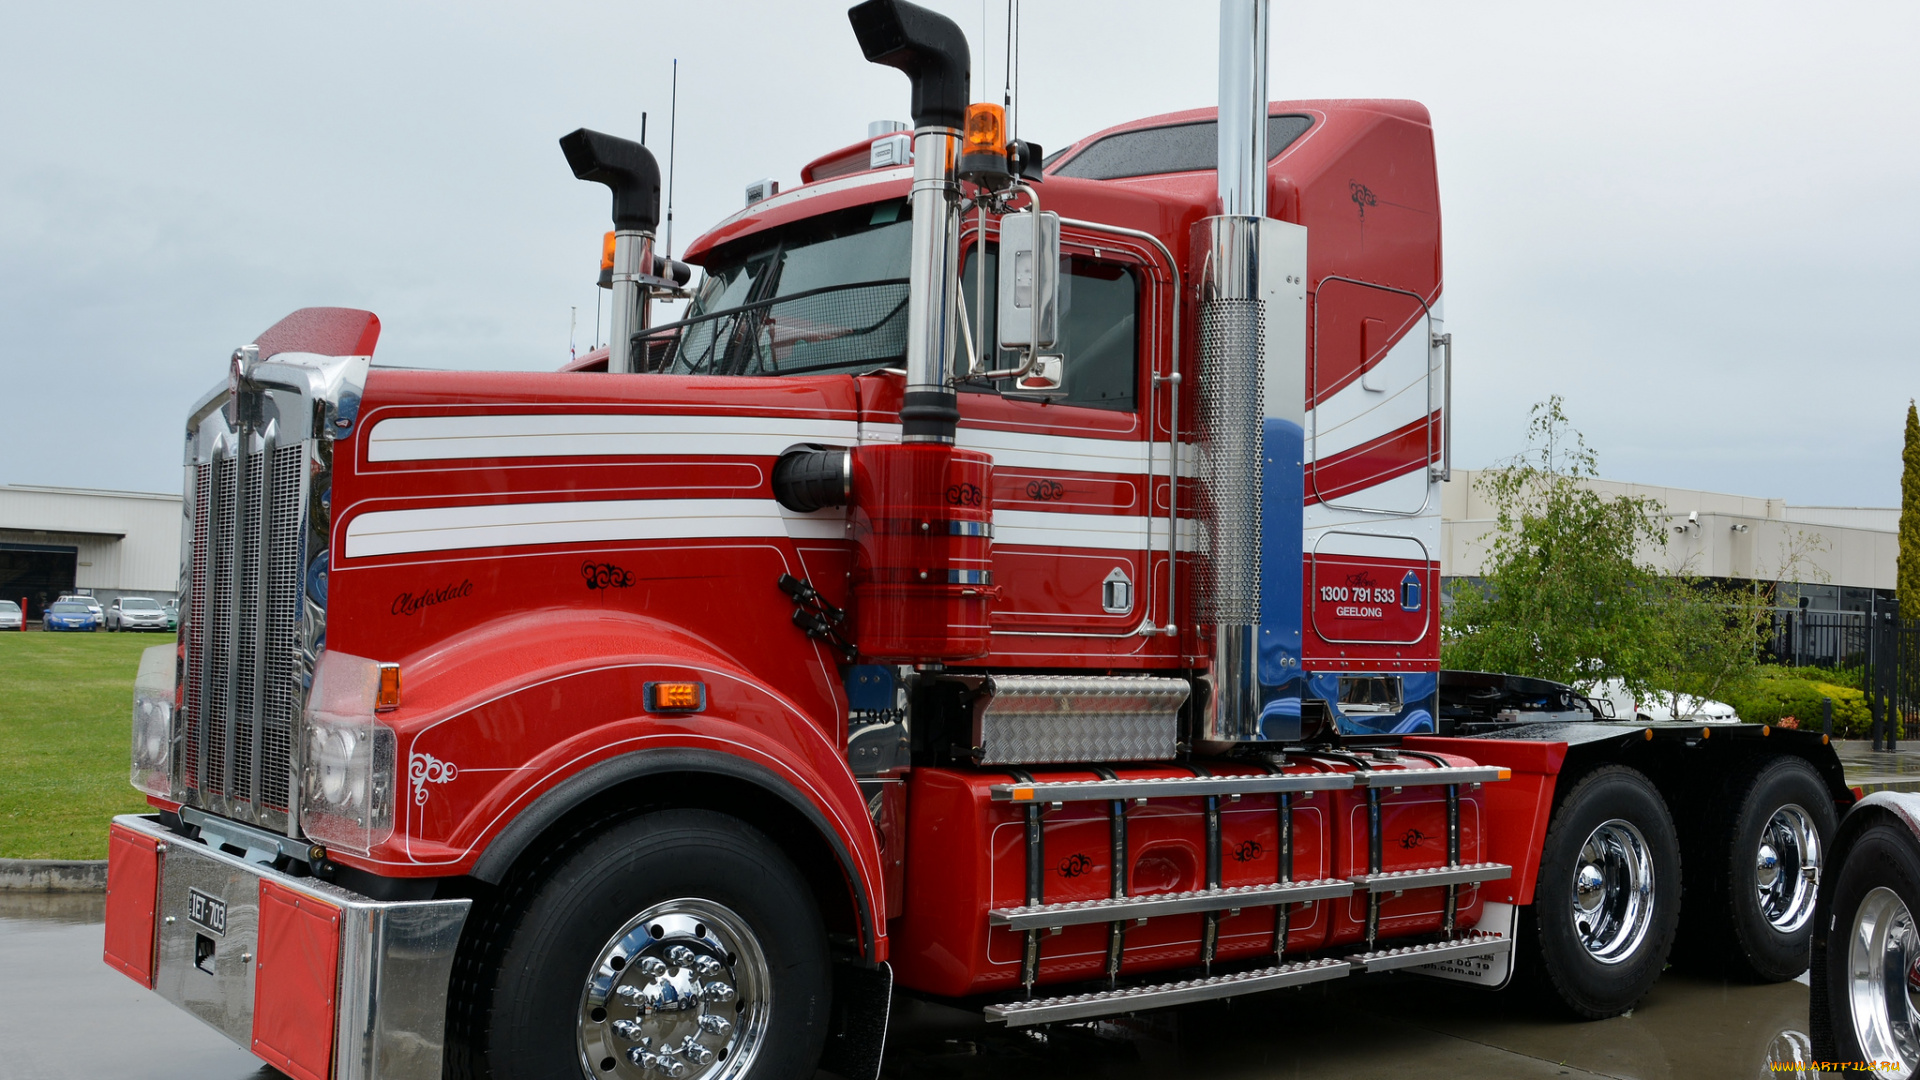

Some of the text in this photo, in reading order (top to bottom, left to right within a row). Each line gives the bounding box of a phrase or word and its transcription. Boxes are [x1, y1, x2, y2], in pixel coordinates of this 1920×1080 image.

[391, 578, 473, 616] Clydesdale
[1321, 586, 1395, 603] 1300 791 533
[1336, 606, 1383, 617] GEELONG
[852, 708, 904, 725] T909
